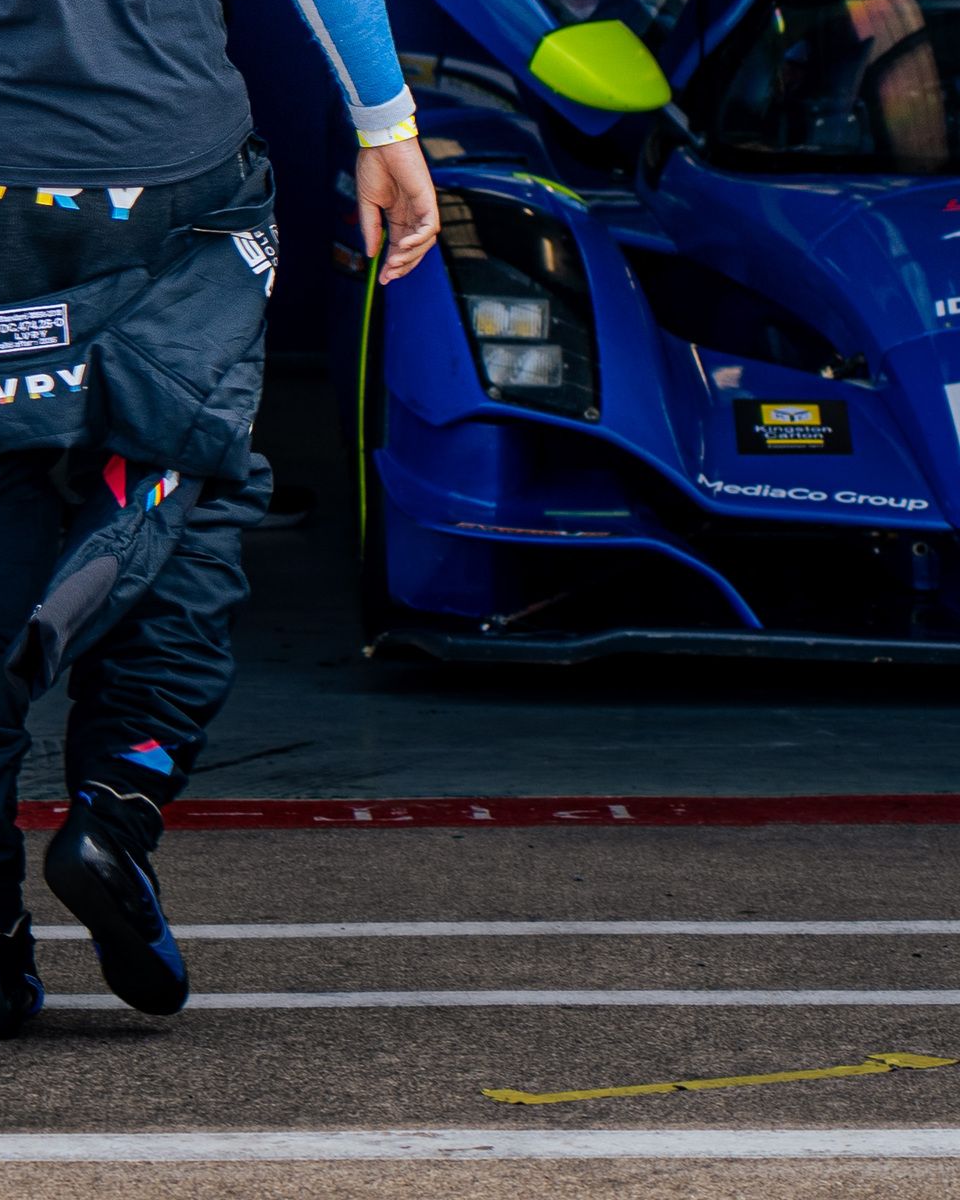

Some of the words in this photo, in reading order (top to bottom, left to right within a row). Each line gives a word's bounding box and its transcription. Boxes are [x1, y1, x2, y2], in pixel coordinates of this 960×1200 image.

[754, 424, 833, 435] Kingston
[696, 473, 829, 502] MediaCo
[833, 490, 930, 512] Group
